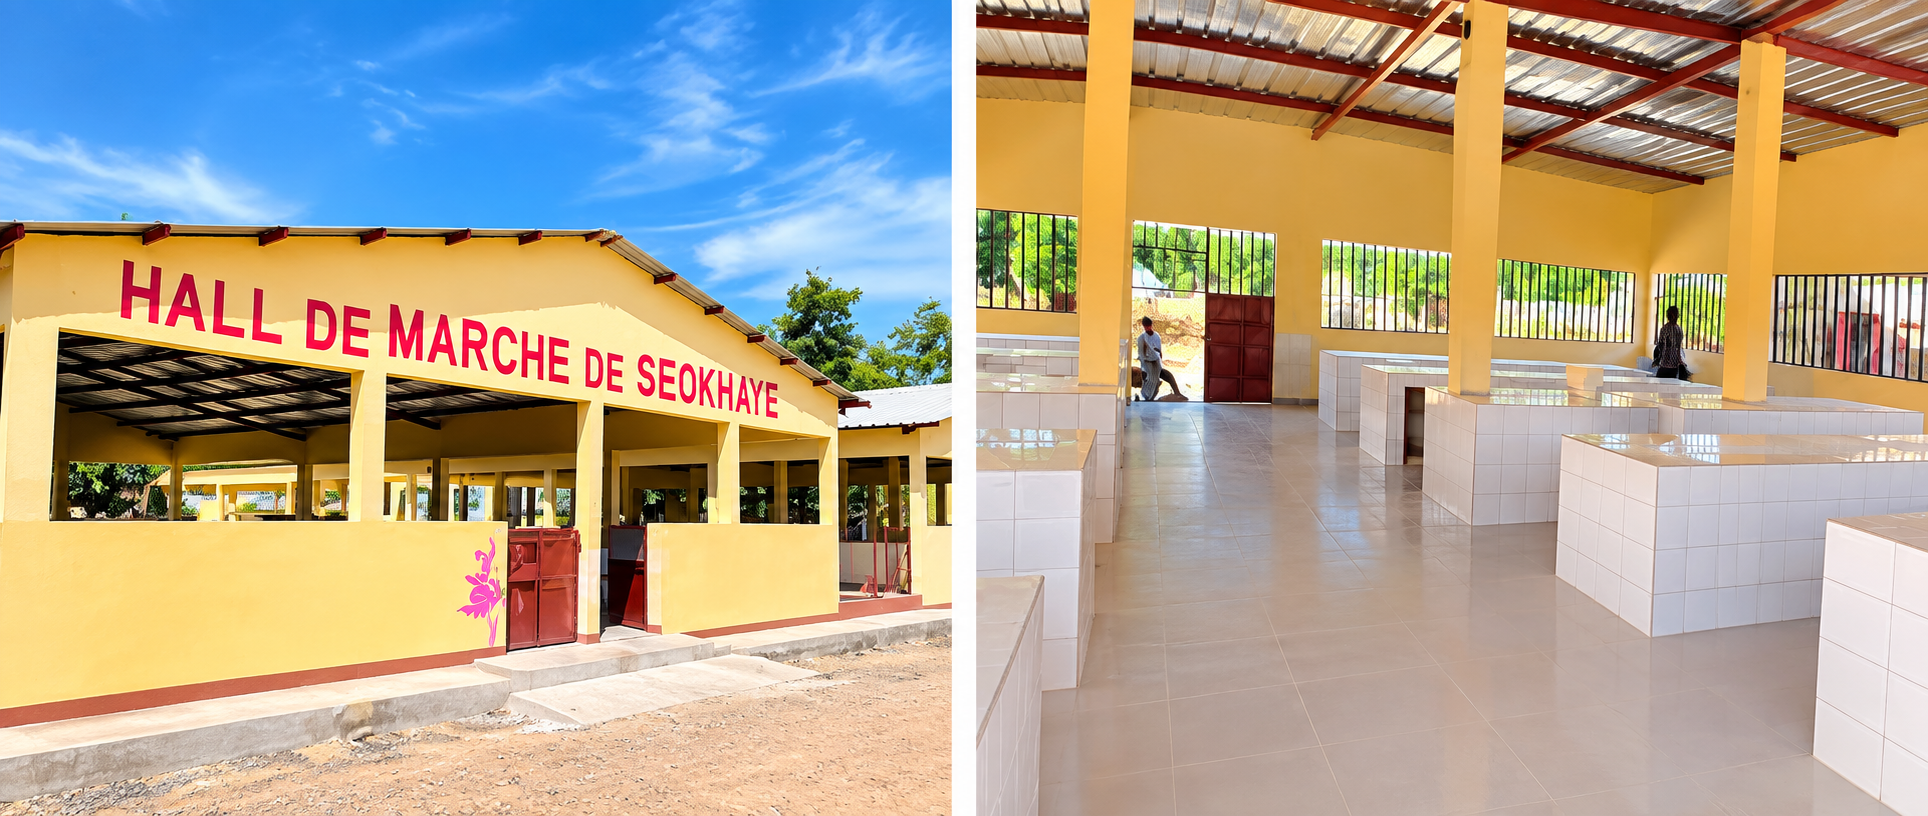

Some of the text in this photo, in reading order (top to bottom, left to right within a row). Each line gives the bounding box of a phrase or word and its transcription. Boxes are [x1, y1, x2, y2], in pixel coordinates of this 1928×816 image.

[120, 259, 779, 419] HALL DE MARCHE DE SEOKHAYE
